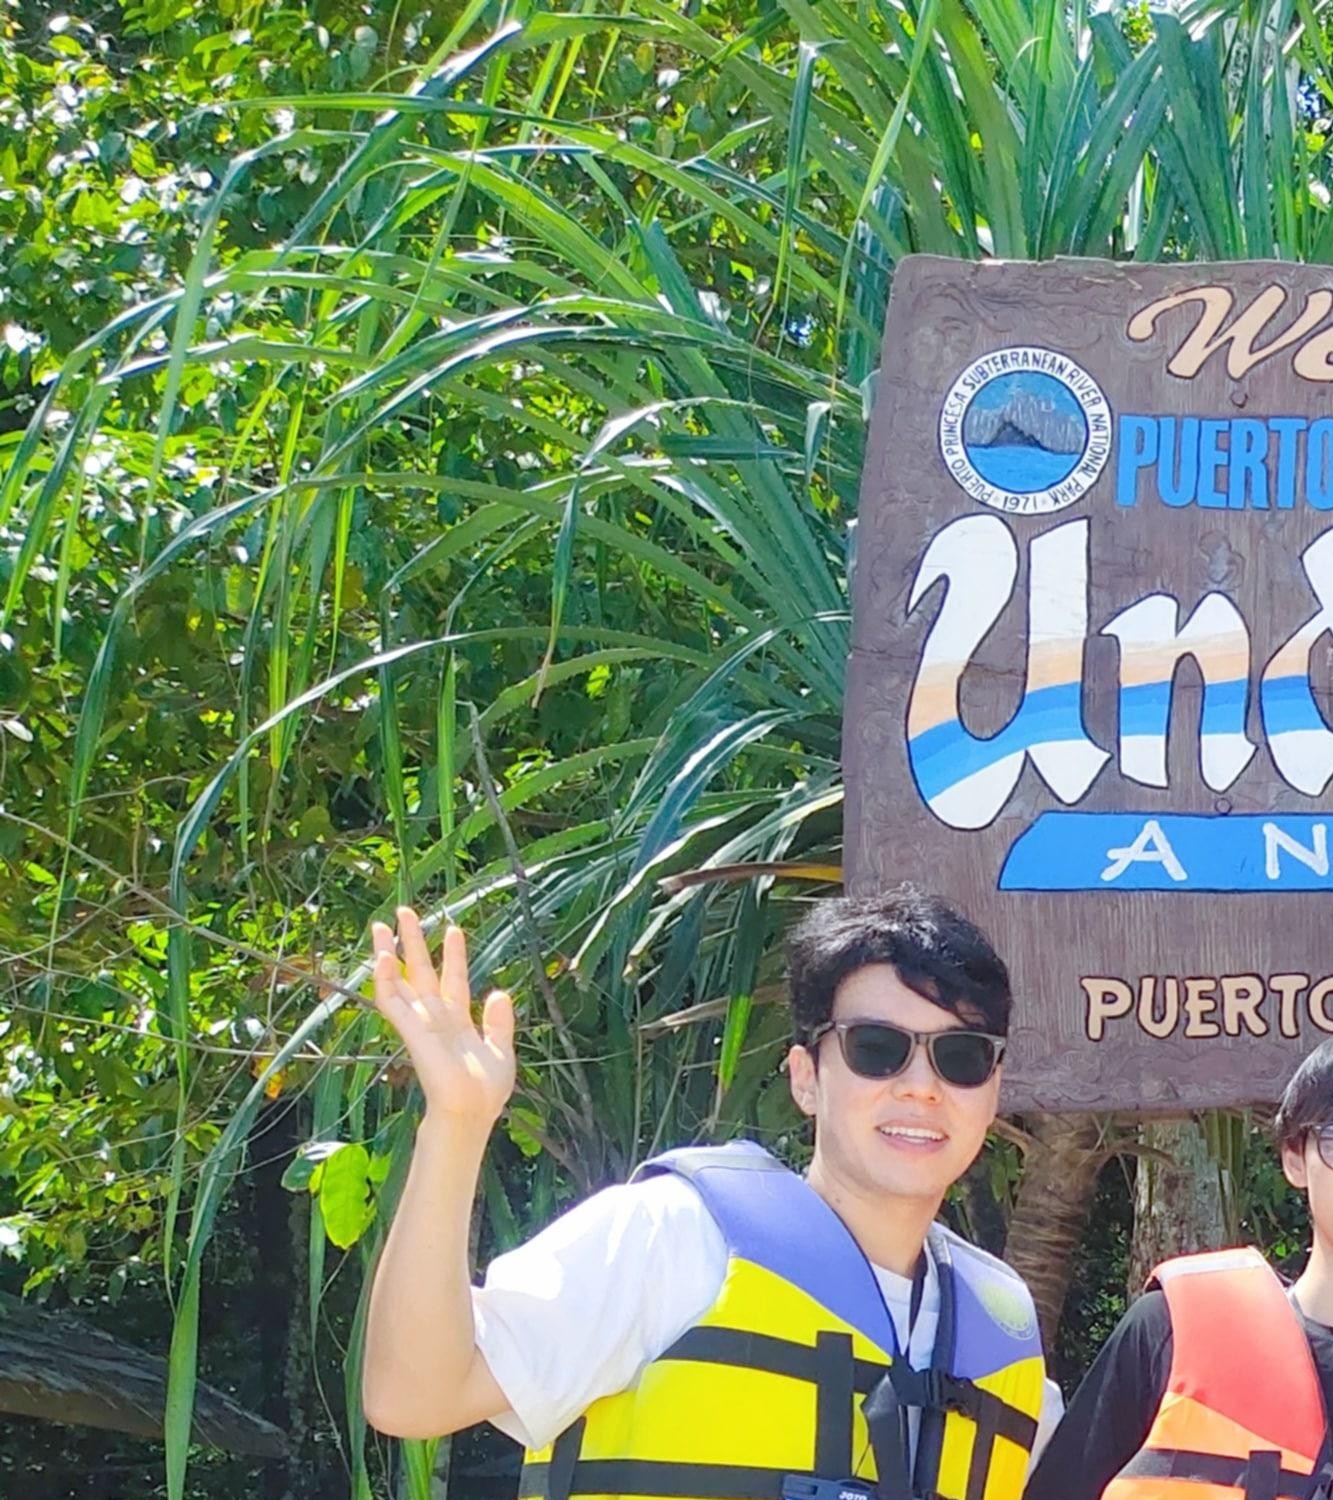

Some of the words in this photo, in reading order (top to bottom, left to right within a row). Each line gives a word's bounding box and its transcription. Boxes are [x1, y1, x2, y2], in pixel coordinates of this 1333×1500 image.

[963, 350, 1069, 391] SUBTERRANEAN
[1067, 369, 1102, 407] RIVER
[943, 391, 967, 455] PRINCESA
[1076, 411, 1109, 479] NATIONAL
[951, 458, 995, 502] PUERTO
[1048, 477, 1085, 506] PARK
[1002, 496, 1038, 511] 1971
[1100, 820, 1189, 882] A
